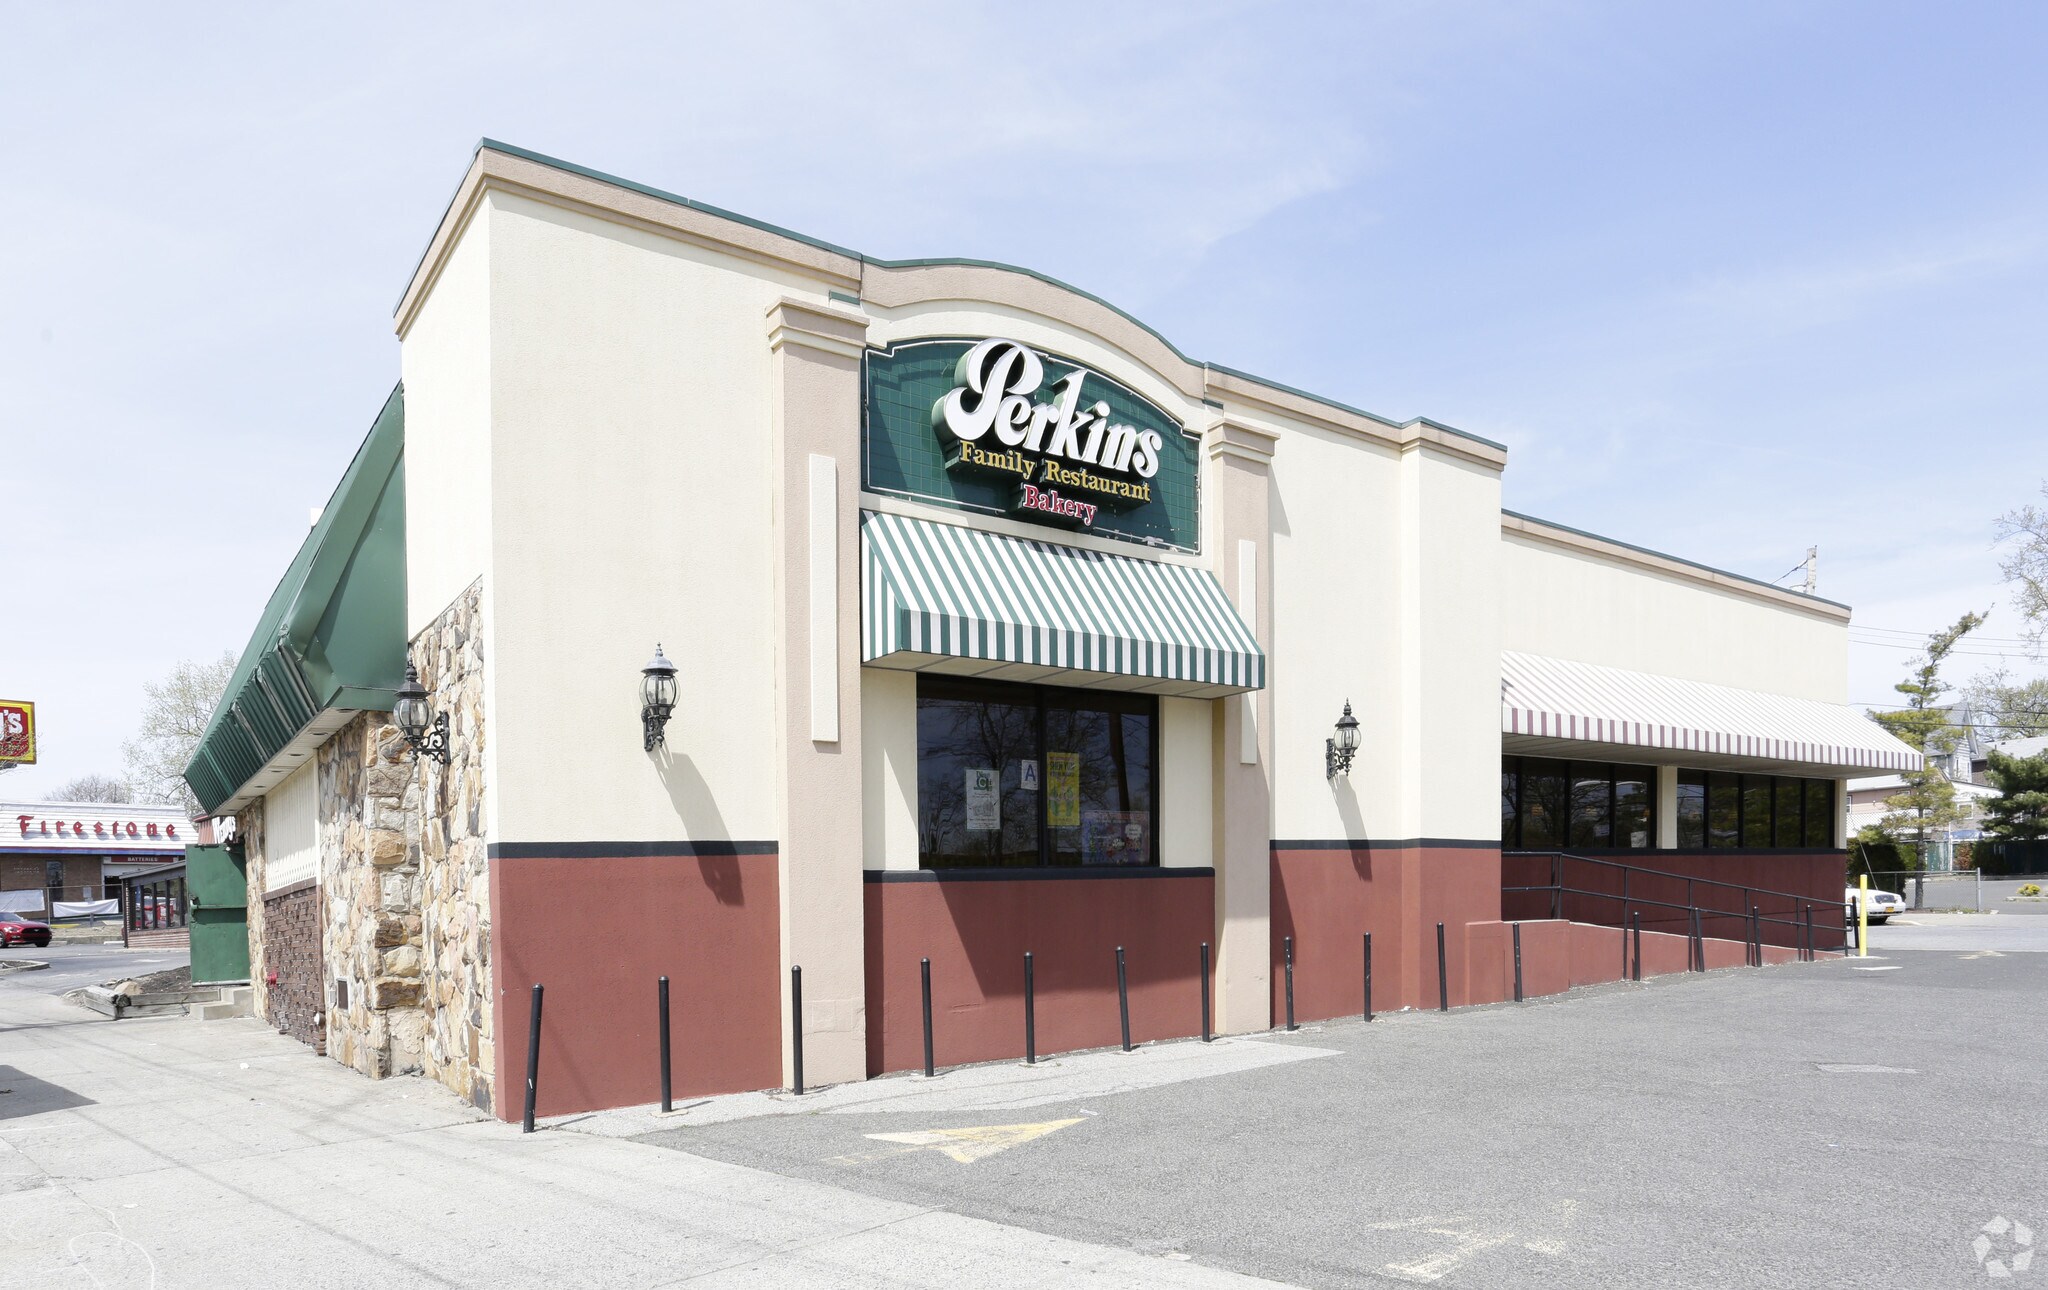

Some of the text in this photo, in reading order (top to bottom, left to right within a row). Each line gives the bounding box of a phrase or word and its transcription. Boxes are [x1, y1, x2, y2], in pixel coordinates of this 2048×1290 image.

[942, 338, 1163, 479] Perkins
[959, 440, 1152, 503] Family Restaurant
[1022, 483, 1098, 527] Bakery
[1024, 764, 1036, 781] A
[16, 814, 176, 837] Firestone
